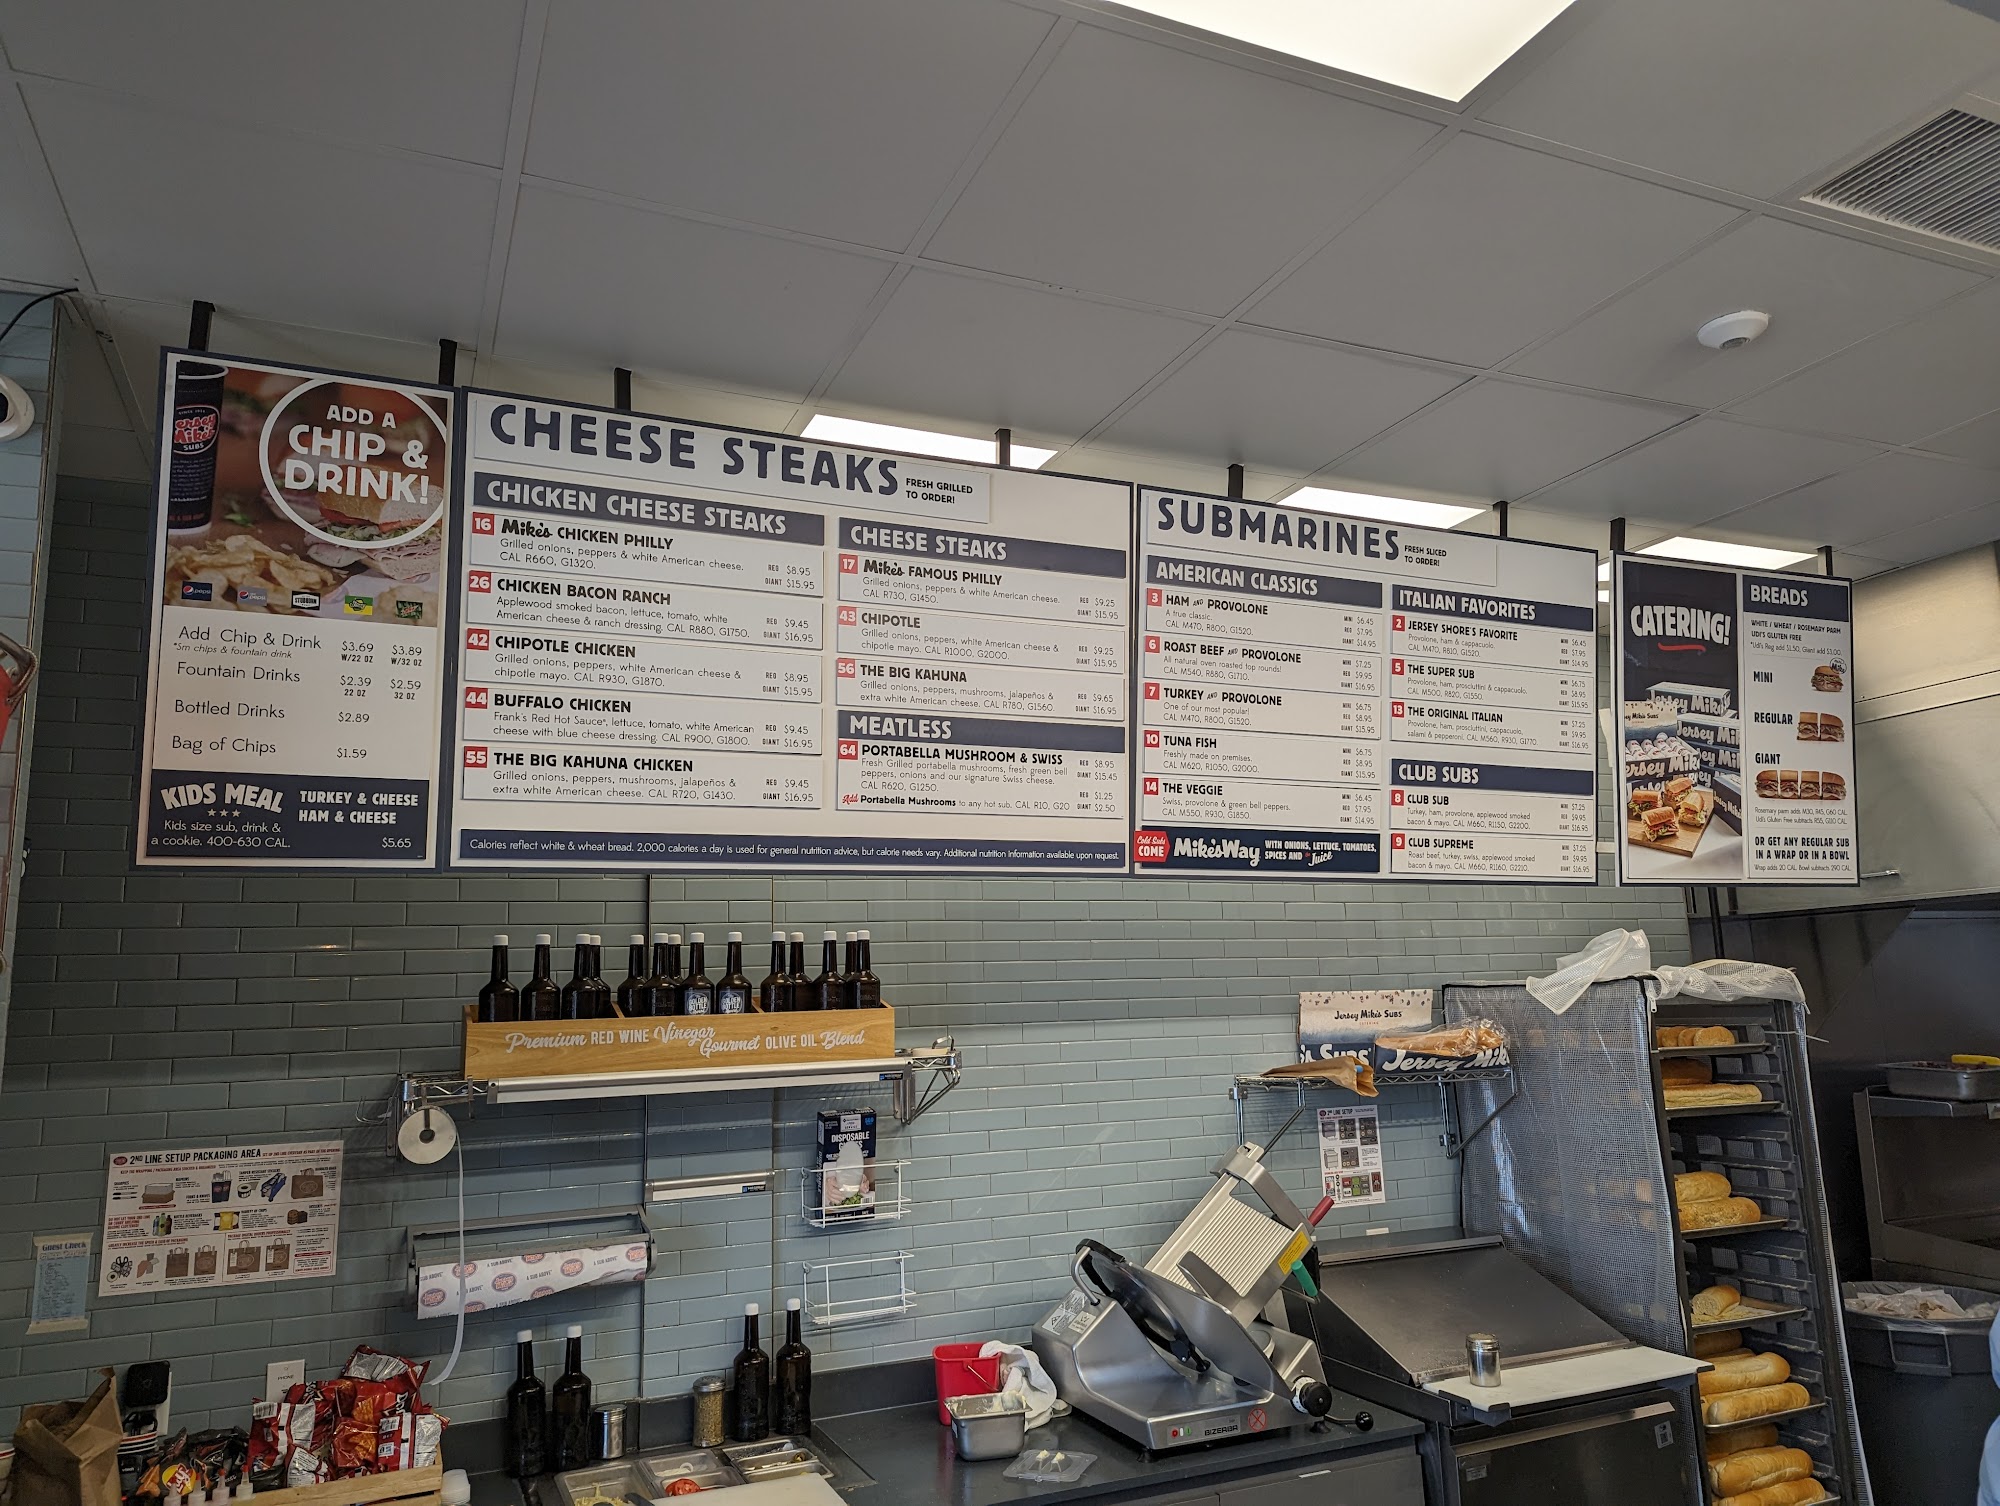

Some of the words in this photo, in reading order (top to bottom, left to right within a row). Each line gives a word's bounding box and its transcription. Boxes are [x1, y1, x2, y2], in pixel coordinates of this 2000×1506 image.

[327, 405, 373, 425] ADD
[382, 413, 396, 429] A
[289, 425, 386, 462] CHIP
[402, 440, 428, 469] &
[490, 404, 695, 470] CHEESE
[723, 437, 899, 496] STEAKS
[285, 459, 429, 505] DRINK!
[906, 478, 933, 489] FRESH
[937, 482, 973, 494] GRILLED
[906, 490, 918, 499] TO
[922, 493, 955, 504] ORDER!
[488, 481, 596, 512] CHICKEN
[607, 496, 695, 524] CHEESE
[705, 507, 786, 534] STEAKS
[475, 518, 491, 531] 16
[502, 519, 553, 538] Mike's
[558, 527, 618, 544] CHICKEN
[625, 534, 673, 550] PHILLY
[1158, 498, 1399, 561] SUBMARINES
[851, 526, 927, 551] CHEESE
[936, 536, 1006, 560] STEAKS
[1405, 545, 1424, 554] FRESH
[1426, 548, 1447, 557] SLICED
[500, 538, 533, 550] Grilled
[538, 544, 574, 555] onions,
[578, 549, 617, 559] peppers
[621, 550, 628, 559] &
[632, 552, 658, 562] white
[662, 555, 705, 566] American
[709, 560, 744, 571] cheese.
[1416, 557, 1439, 566] ORDER!
[843, 559, 855, 570] 17
[864, 560, 905, 576] Mike's
[909, 566, 958, 581] FAMOUS
[963, 572, 1002, 585] PHILLY
[1156, 562, 1244, 587] AMERICAN
[1251, 573, 1318, 595] CLASSICS
[470, 576, 490, 589] 26
[498, 579, 561, 596] CHICKEN
[567, 585, 616, 600] BACON
[623, 590, 670, 605] RANCH
[1751, 585, 1808, 606] BREADS
[1152, 593, 1158, 603] 3
[1166, 595, 1189, 606] HAM
[1208, 599, 1268, 615] PROVOLONE
[1400, 590, 1455, 611] ITALIAN
[1462, 597, 1535, 620] FAVORITES
[1396, 619, 1402, 628] 2
[1408, 621, 1438, 632] JERSEY
[1442, 624, 1476, 636] SHORE'S
[1480, 628, 1517, 641] FAVORITE
[1631, 606, 1731, 645] CATERING!
[179, 626, 210, 640] Add
[221, 629, 257, 648] Chip
[264, 633, 275, 645] &
[283, 634, 321, 649] Drink
[194, 644, 217, 654] chips
[231, 646, 268, 656] fountain
[271, 650, 292, 658] drink
[342, 641, 374, 653] $3.69
[392, 645, 422, 656] $3.89
[178, 662, 245, 678] Fountain
[254, 667, 300, 682] Drinks
[1754, 671, 1773, 683] MINI
[340, 675, 371, 687] $2.39
[390, 679, 421, 690] $2.59
[175, 700, 230, 715] Bottled
[238, 703, 285, 718] Drinks
[466, 692, 487, 705] 44
[495, 694, 563, 709] BUFFALO
[570, 698, 631, 713] CHICKEN
[338, 712, 370, 723] $2.89
[1394, 705, 1403, 715] 13
[1408, 706, 1424, 717] THE
[1428, 708, 1469, 720] ORIGINAL
[1472, 712, 1503, 723] ITALIAN
[1755, 712, 1793, 725] REGULAR
[850, 716, 951, 739] MEATLESS
[173, 736, 203, 755] Bag
[210, 737, 227, 751] of
[232, 738, 276, 756] Chips
[1146, 734, 1158, 744] 10
[1164, 736, 1192, 747] TUNA
[1196, 738, 1217, 748] FISH
[840, 744, 856, 756] 64
[862, 745, 940, 759] PORTABELLA
[946, 749, 1015, 763] MUSHROOM
[1020, 753, 1028, 763] &
[1032, 754, 1063, 765] SWISS
[1756, 753, 1780, 764] GIANT
[1399, 764, 1436, 781] CLUB
[1442, 767, 1479, 784] SUBS
[161, 783, 216, 810] KIDS
[225, 784, 283, 813] MEAL
[300, 791, 352, 804] TURKEY
[358, 793, 367, 804] &
[372, 793, 418, 806] CHEESE
[1146, 782, 1157, 792] 14
[1163, 783, 1182, 794] THE
[1187, 784, 1223, 796] VEGGIE
[165, 820, 187, 830] Kids
[191, 822, 212, 831] size
[216, 821, 238, 833] sub,
[242, 822, 268, 832] drink
[272, 823, 281, 833] &
[163, 835, 200, 846] cookie.
[207, 836, 261, 847] 400-630
[265, 838, 290, 848] CAL.
[382, 837, 411, 848] $5.65
[1265, 840, 1282, 849] WITH
[1284, 841, 1311, 850] ONIONS,
[1313, 842, 1341, 851] LETTUCE,
[1343, 843, 1377, 852] TOMATOES,
[1396, 837, 1402, 846] 9
[1409, 838, 1430, 848] CLUB
[1434, 839, 1474, 849] SUPREME
[1755, 837, 1765, 846] OR
[1768, 837, 1781, 846] GET
[1784, 837, 1798, 846] ANY
[1802, 838, 1833, 847] REGULAR
[1837, 838, 1849, 847] SUB
[1334, 1011, 1359, 1022] Jersey
[506, 1033, 588, 1054] Premium
[591, 1031, 614, 1044] RED
[619, 1029, 649, 1043] WINE
[654, 1022, 716, 1047] Vinegar
[699, 1034, 761, 1059] Gourmet
[766, 1035, 797, 1049] OLIVE
[801, 1034, 817, 1047] OIL
[820, 1030, 865, 1050] Blend
[1382, 1051, 1465, 1072] Jersey
[831, 1131, 870, 1143] DISPOSABLE
[145, 1155, 162, 1164] LINE
[165, 1153, 191, 1163] SETUP
[194, 1150, 238, 1161] PACKAGING
[241, 1149, 261, 1158] AREA
[1205, 1425, 1238, 1436] BIZERBA
